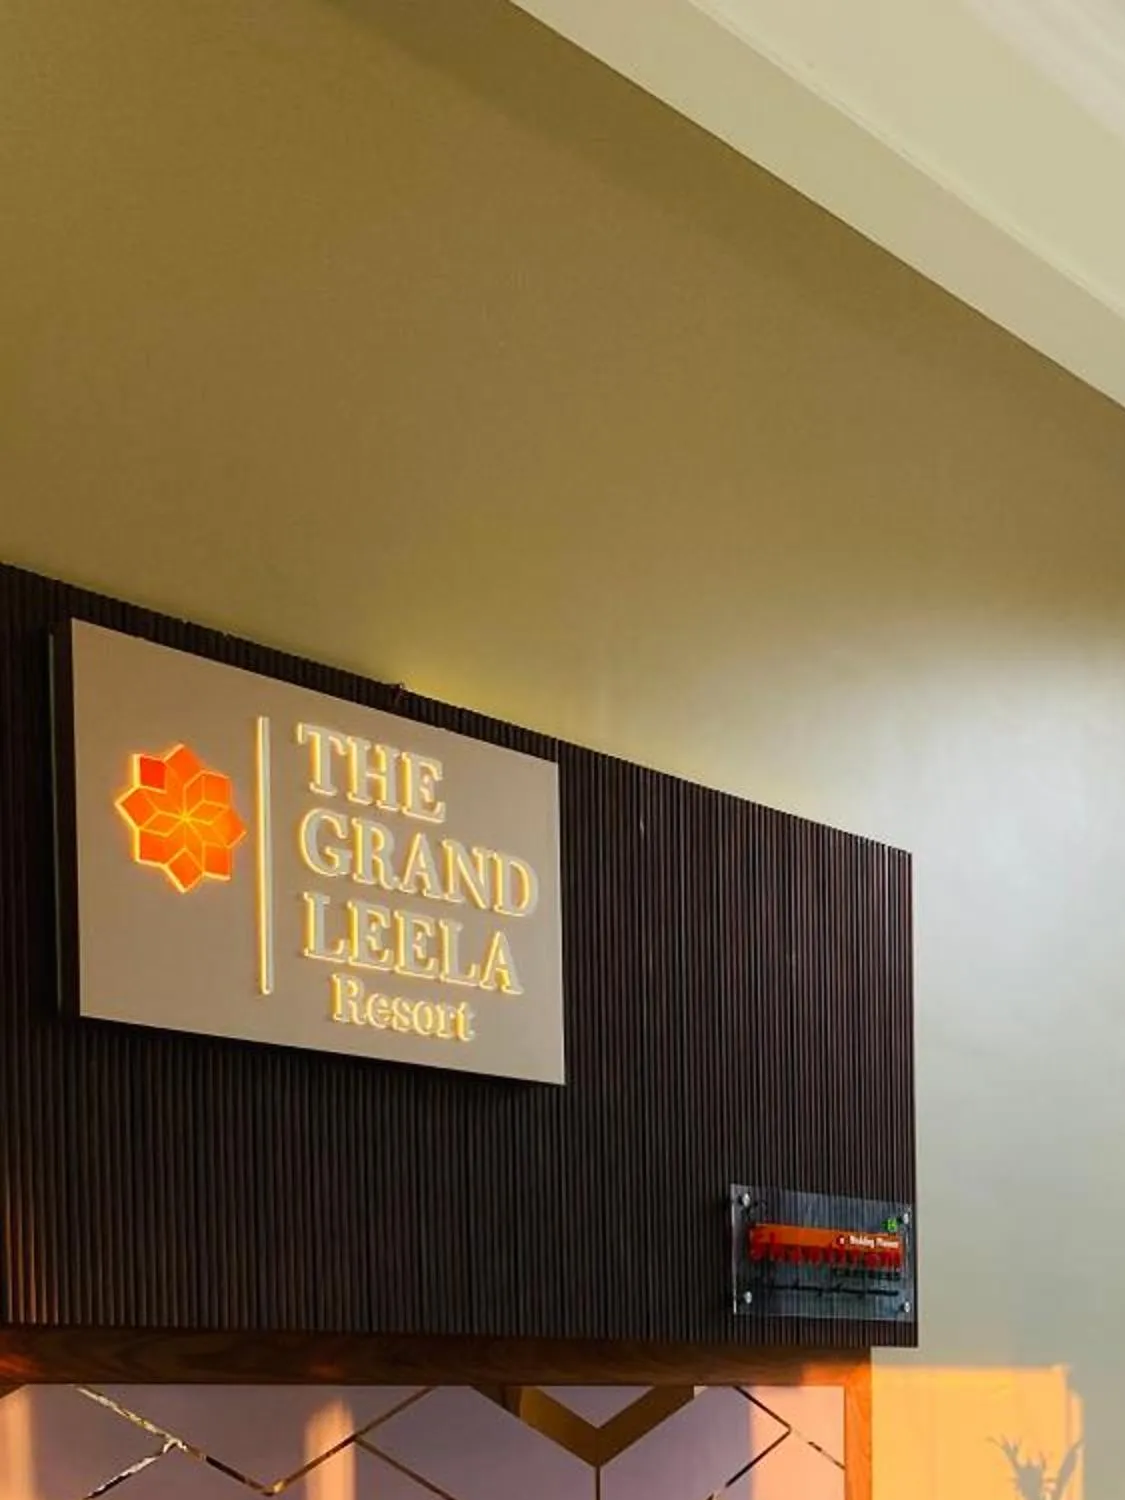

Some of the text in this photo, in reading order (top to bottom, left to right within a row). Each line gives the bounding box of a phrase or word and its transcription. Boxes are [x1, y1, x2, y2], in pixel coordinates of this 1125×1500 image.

[298, 723, 445, 822] THE
[299, 808, 539, 917] GRAND
[302, 891, 523, 995] LEELA
[331, 973, 475, 1041] Resort
